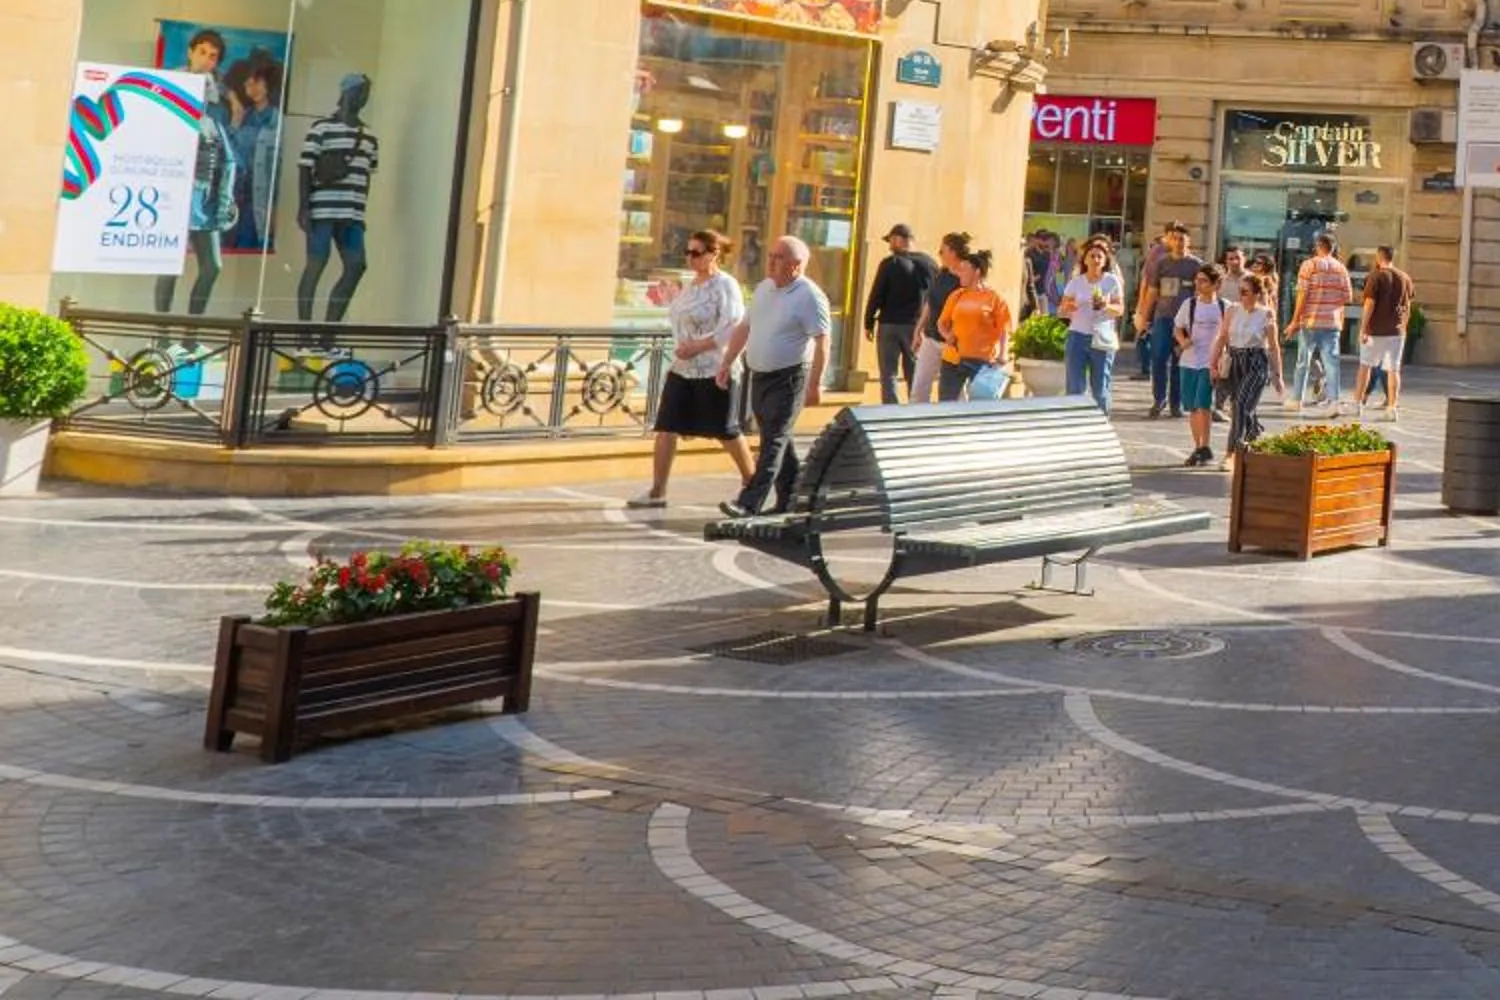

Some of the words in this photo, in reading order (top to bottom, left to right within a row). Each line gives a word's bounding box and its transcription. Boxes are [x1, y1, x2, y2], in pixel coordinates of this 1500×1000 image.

[1030, 99, 1117, 141] enti
[1273, 121, 1364, 145] Captain
[1262, 134, 1382, 169] SILVER
[106, 184, 160, 231] 28
